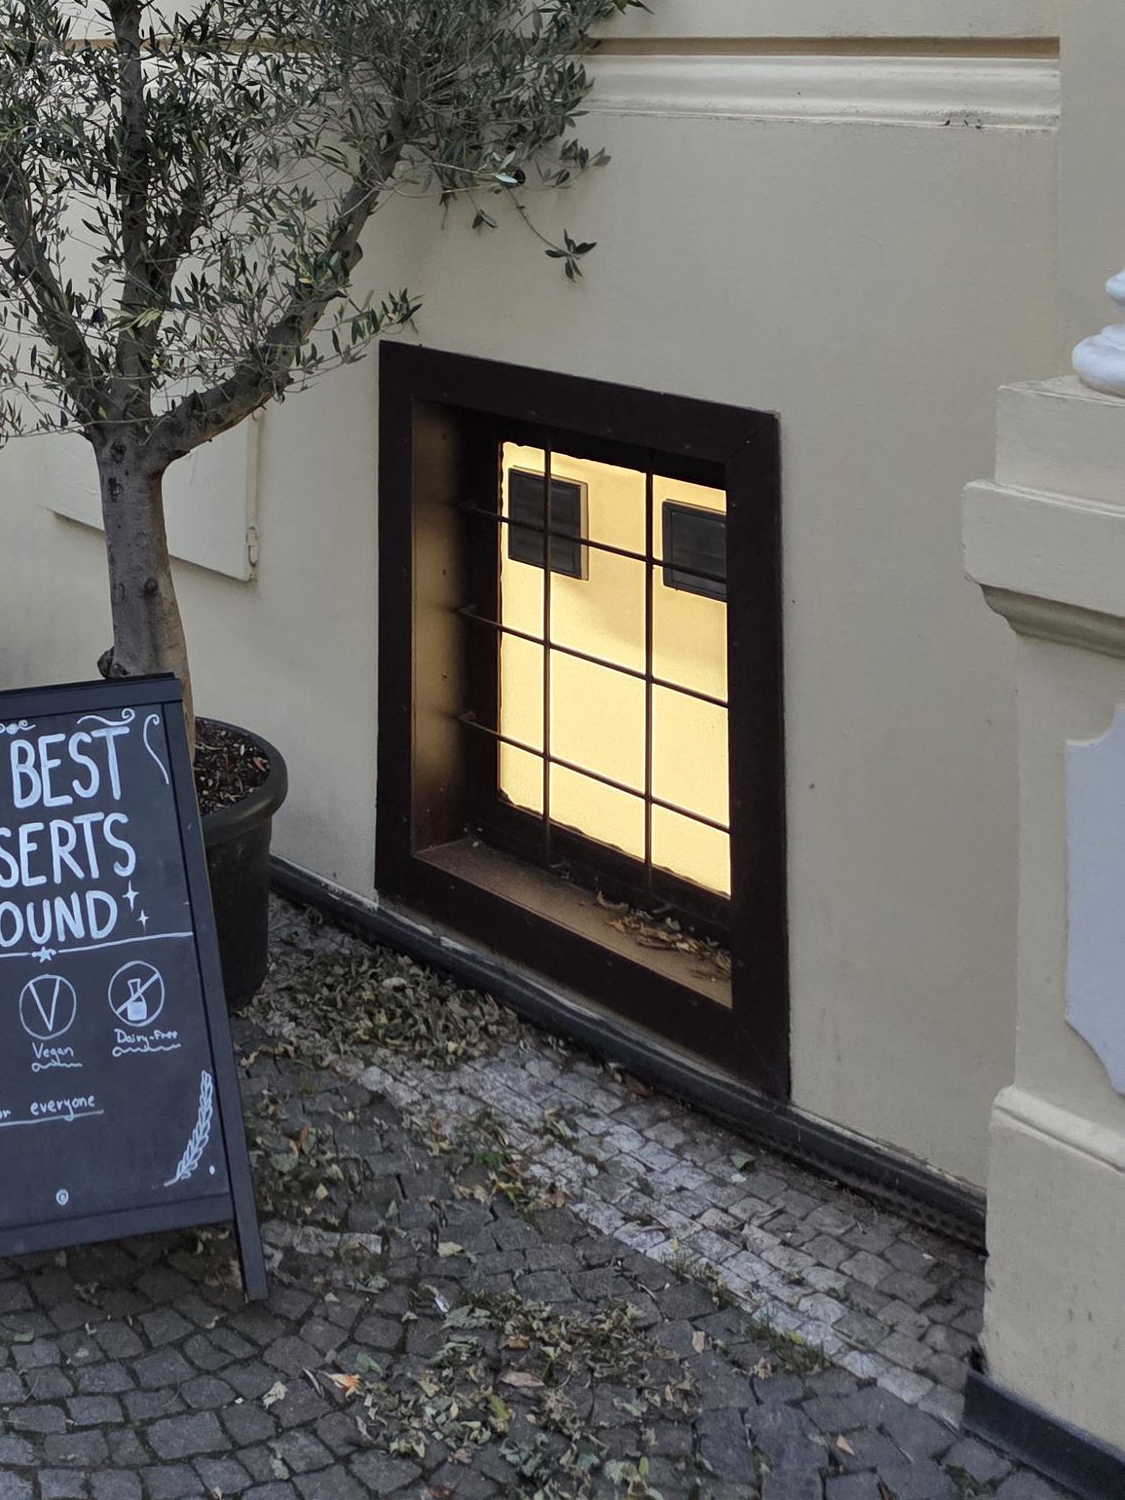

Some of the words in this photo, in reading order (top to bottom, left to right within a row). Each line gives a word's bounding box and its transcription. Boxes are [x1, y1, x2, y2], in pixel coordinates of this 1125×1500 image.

[10, 726, 130, 809] BEST
[31, 1042, 74, 1064] Vegan
[30, 1094, 96, 1120] everyone
